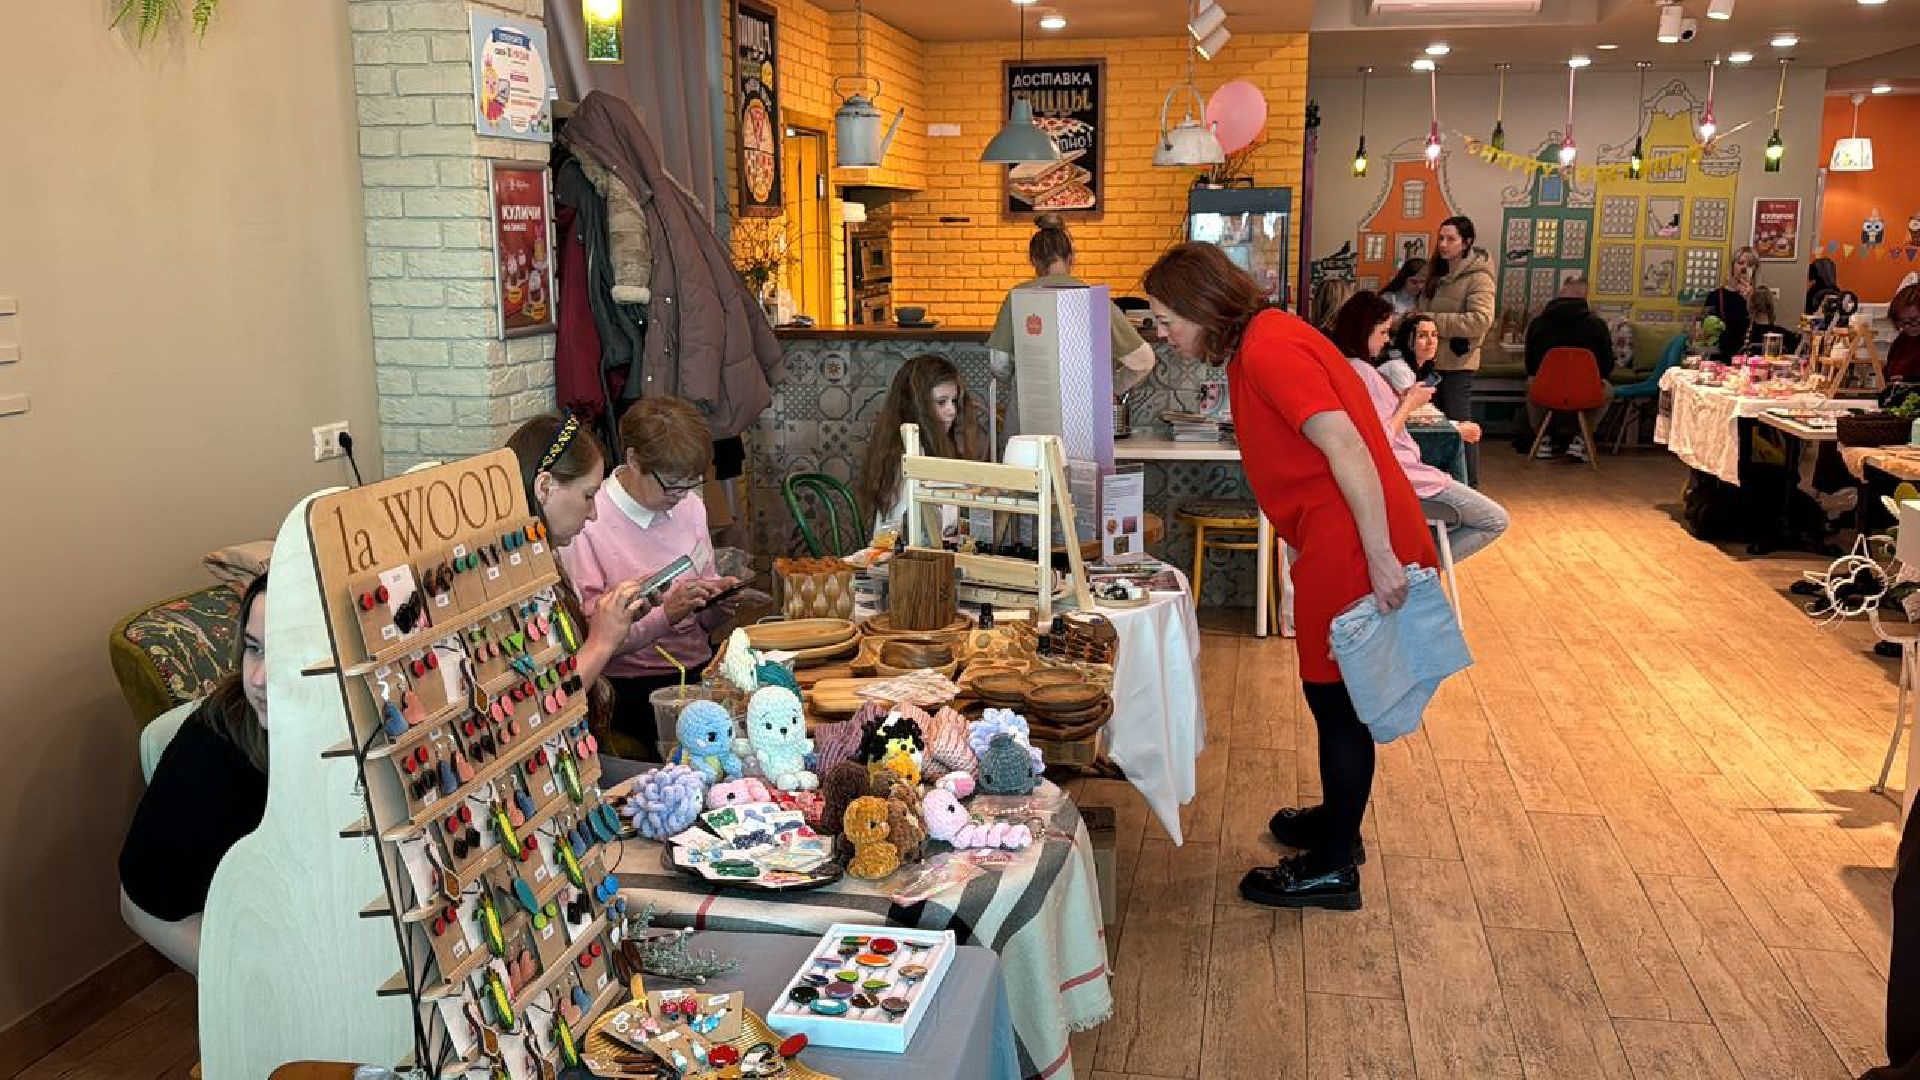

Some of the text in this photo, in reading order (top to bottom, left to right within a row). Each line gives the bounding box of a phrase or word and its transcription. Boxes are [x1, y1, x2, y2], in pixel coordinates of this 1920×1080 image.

[1012, 72, 1092, 88] ДОСТАВКА
[501, 204, 541, 221] КУЛИЧИ
[333, 464, 514, 576] la WOOD
